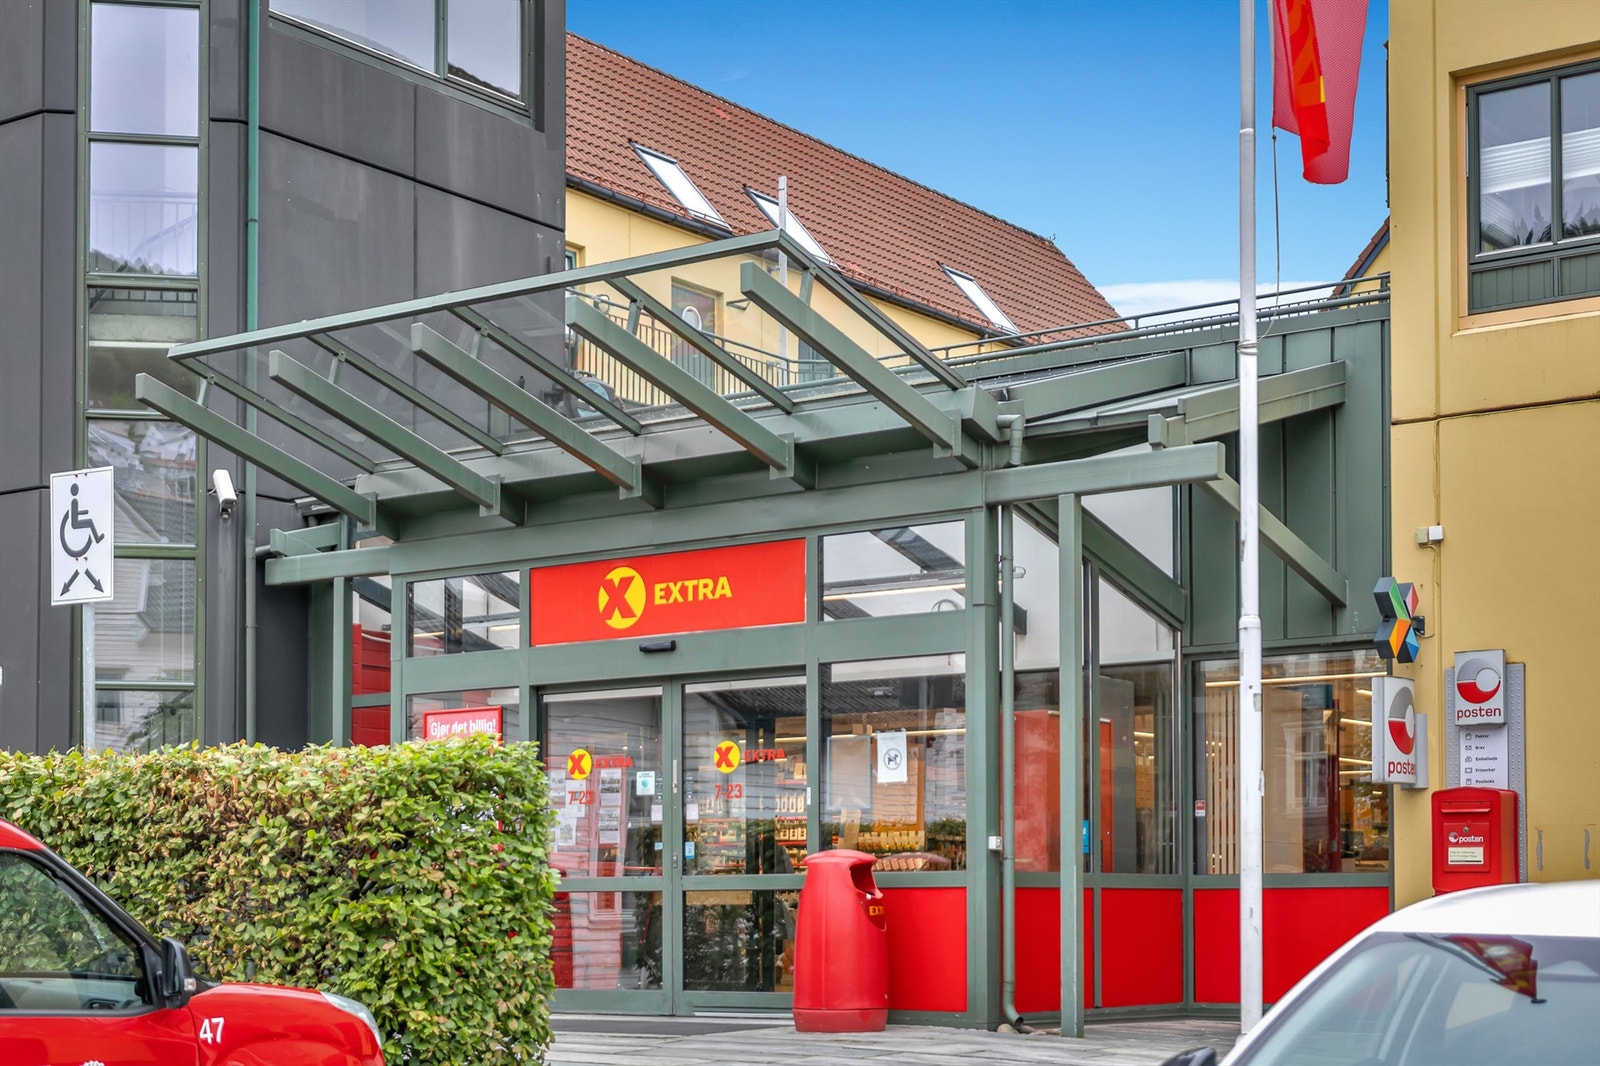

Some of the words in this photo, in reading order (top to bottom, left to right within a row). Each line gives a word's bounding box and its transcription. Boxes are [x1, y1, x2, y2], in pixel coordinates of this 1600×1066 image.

[654, 576, 733, 605] EXTRA
[1456, 706, 1502, 721] posten
[430, 721, 450, 738] Gjør
[451, 720, 467, 734] det
[469, 718, 496, 735] billig!
[744, 748, 788, 763] EXTRA
[568, 790, 595, 805] 7-23
[714, 784, 743, 799] 7-23
[1459, 835, 1484, 844] posten
[199, 1017, 225, 1044] 47
